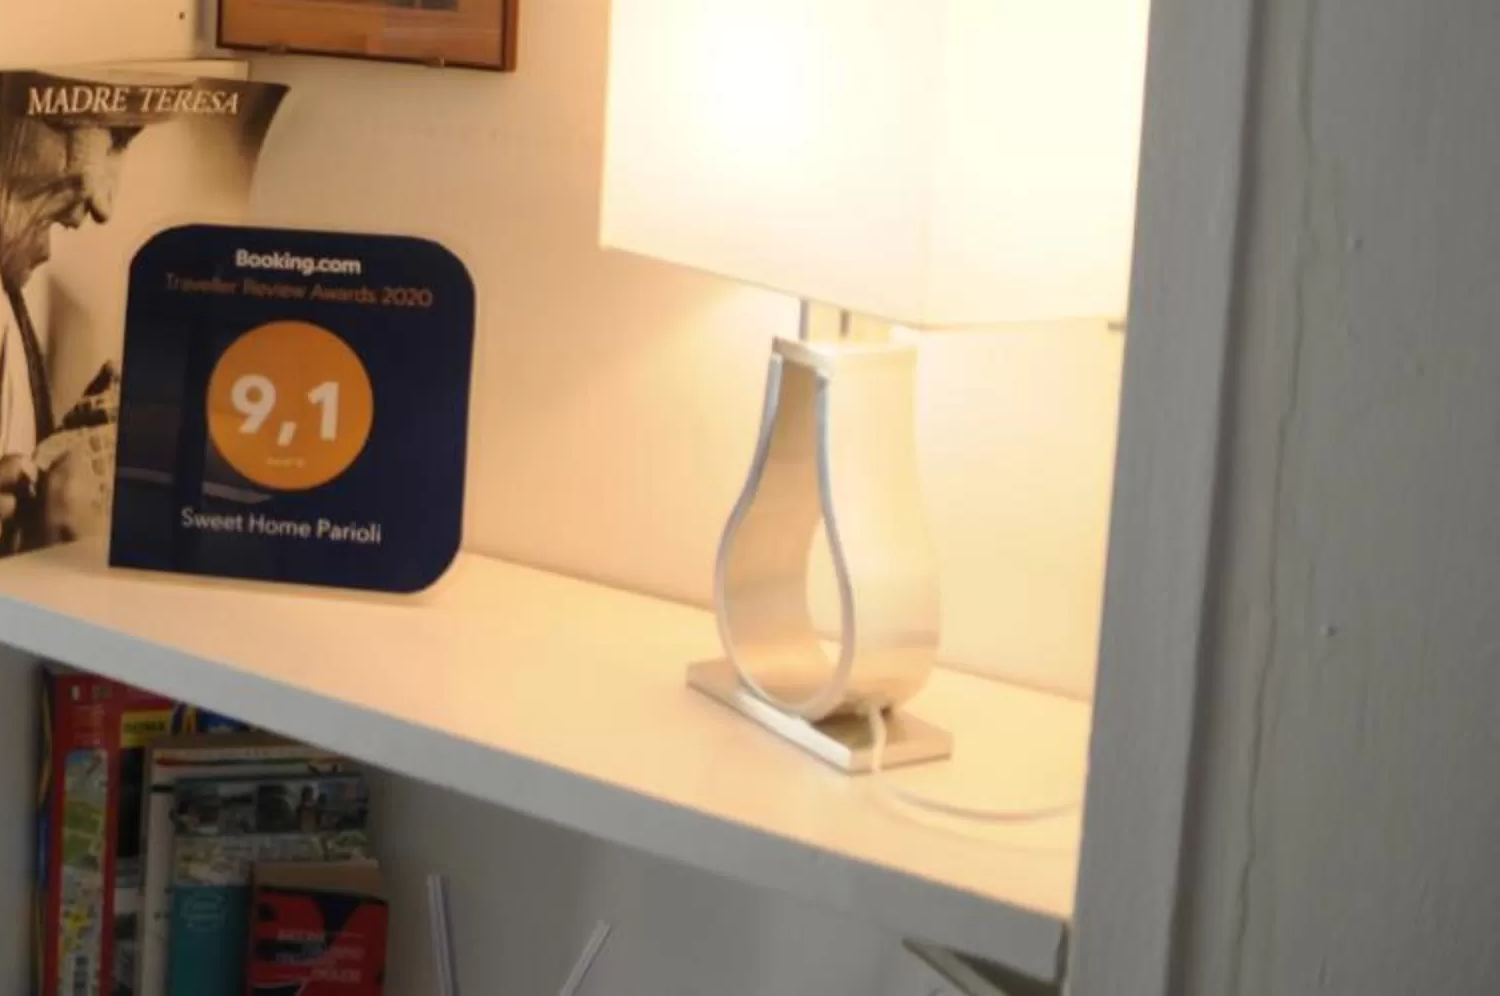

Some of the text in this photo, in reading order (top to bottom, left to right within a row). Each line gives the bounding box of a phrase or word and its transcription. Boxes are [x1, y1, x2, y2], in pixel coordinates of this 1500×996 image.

[27, 84, 240, 116] MADRE TERESA
[235, 248, 362, 276] Booking.com
[165, 272, 434, 309] Traveller Review Awards 2020
[231, 374, 340, 447] 9,1
[180, 506, 382, 545] Sweet Home Parioli
